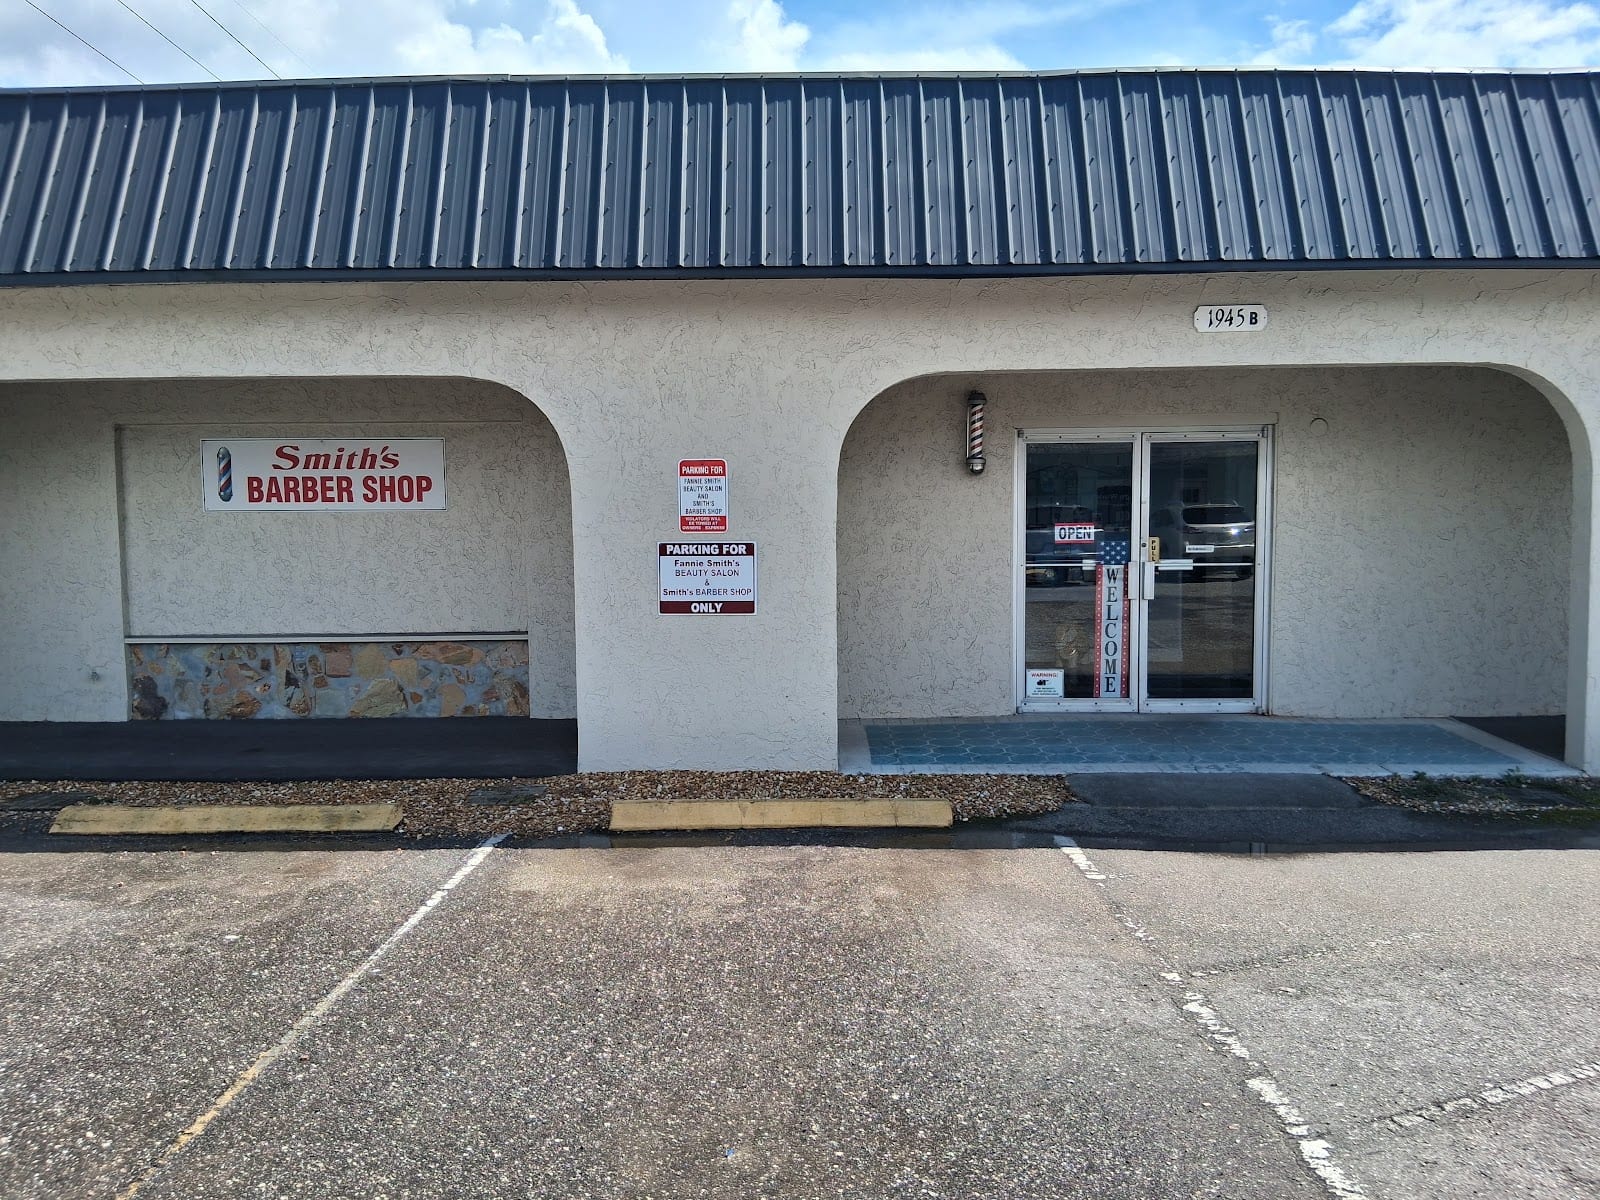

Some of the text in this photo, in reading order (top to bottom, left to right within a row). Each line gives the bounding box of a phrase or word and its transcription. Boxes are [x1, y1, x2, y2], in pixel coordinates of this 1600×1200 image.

[1208, 308, 1258, 328] 1945 B
[271, 445, 400, 471] Smith's
[682, 466, 723, 474] PARKING FOR
[247, 475, 433, 503] BARBER SHOP
[1059, 527, 1091, 540] OPEN
[666, 544, 747, 555] PARKING FOR
[675, 569, 740, 577] BEAUTY SALON
[663, 588, 752, 596] Smith's BARBER SHOP
[690, 602, 723, 613] ONLY
[1104, 567, 1119, 694] WELCOME
